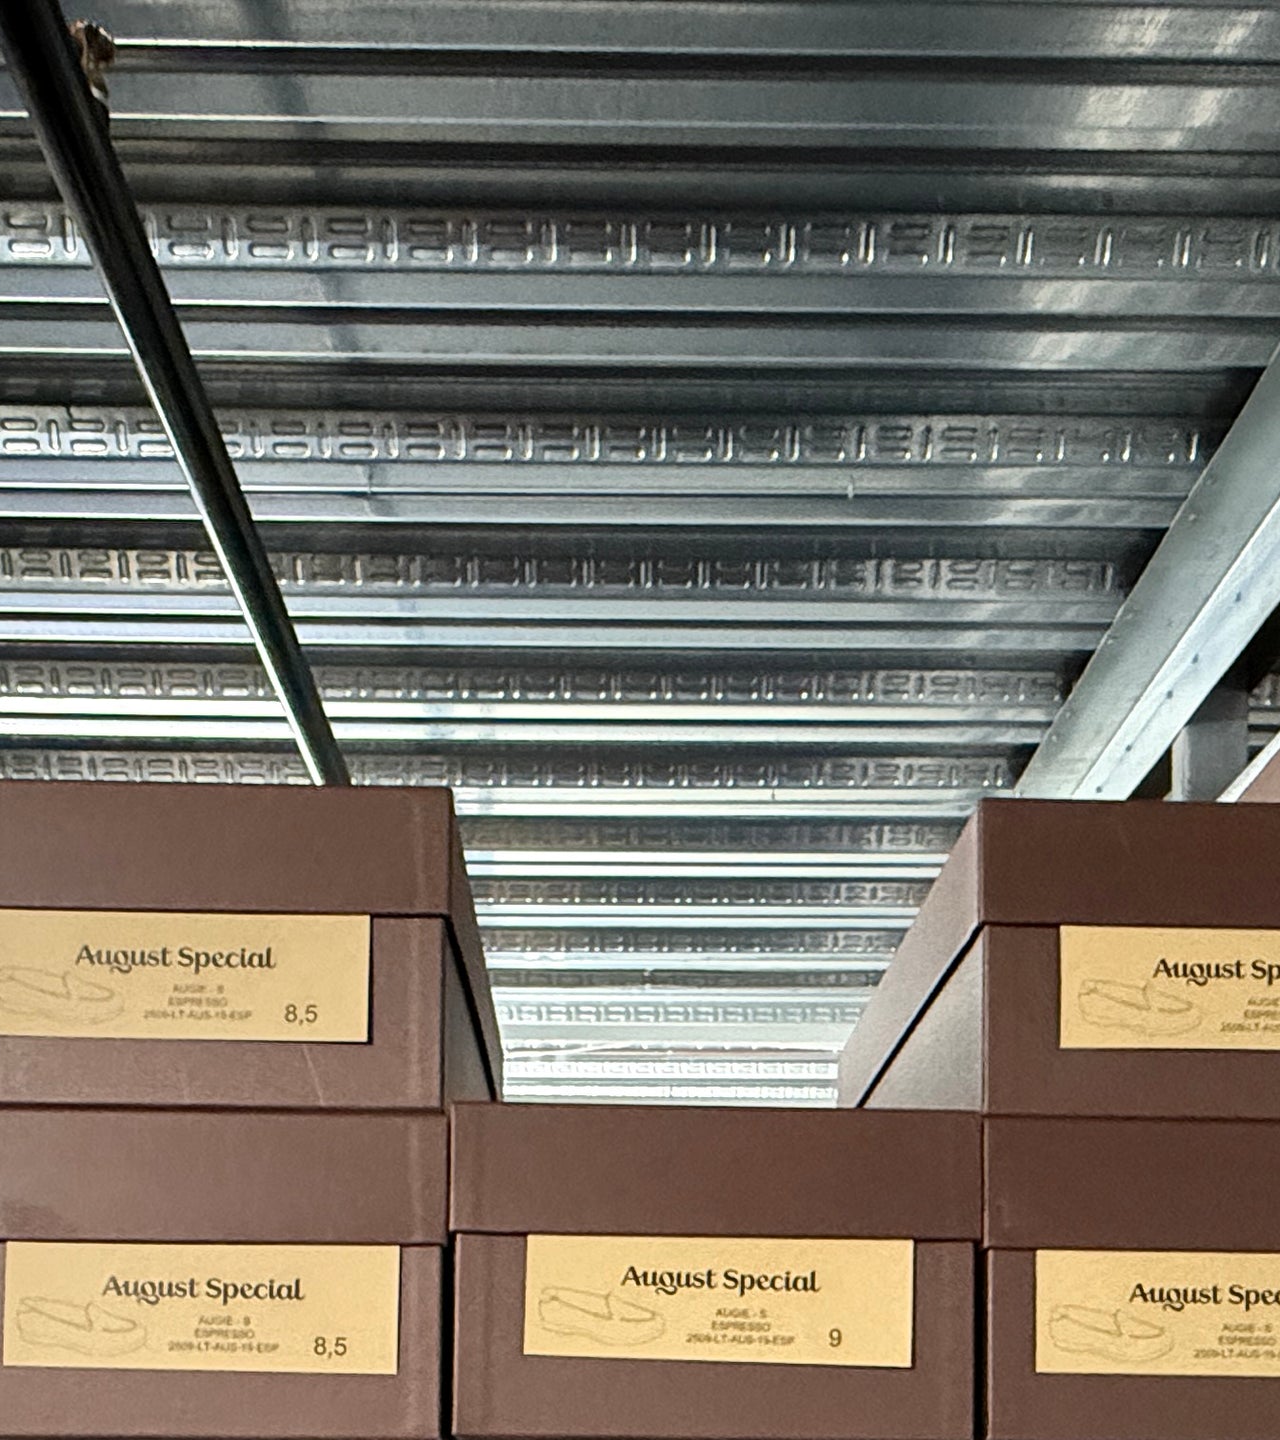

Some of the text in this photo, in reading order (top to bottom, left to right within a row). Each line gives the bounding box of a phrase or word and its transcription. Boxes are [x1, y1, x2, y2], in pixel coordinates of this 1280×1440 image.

[75, 945, 276, 974] August Special
[1153, 959, 1245, 986] August
[102, 1276, 305, 1305] August Special
[621, 1266, 820, 1297] August Special
[1129, 1283, 1222, 1312] August
[314, 1337, 347, 1358] 8,5
[829, 1328, 842, 1347] 9
